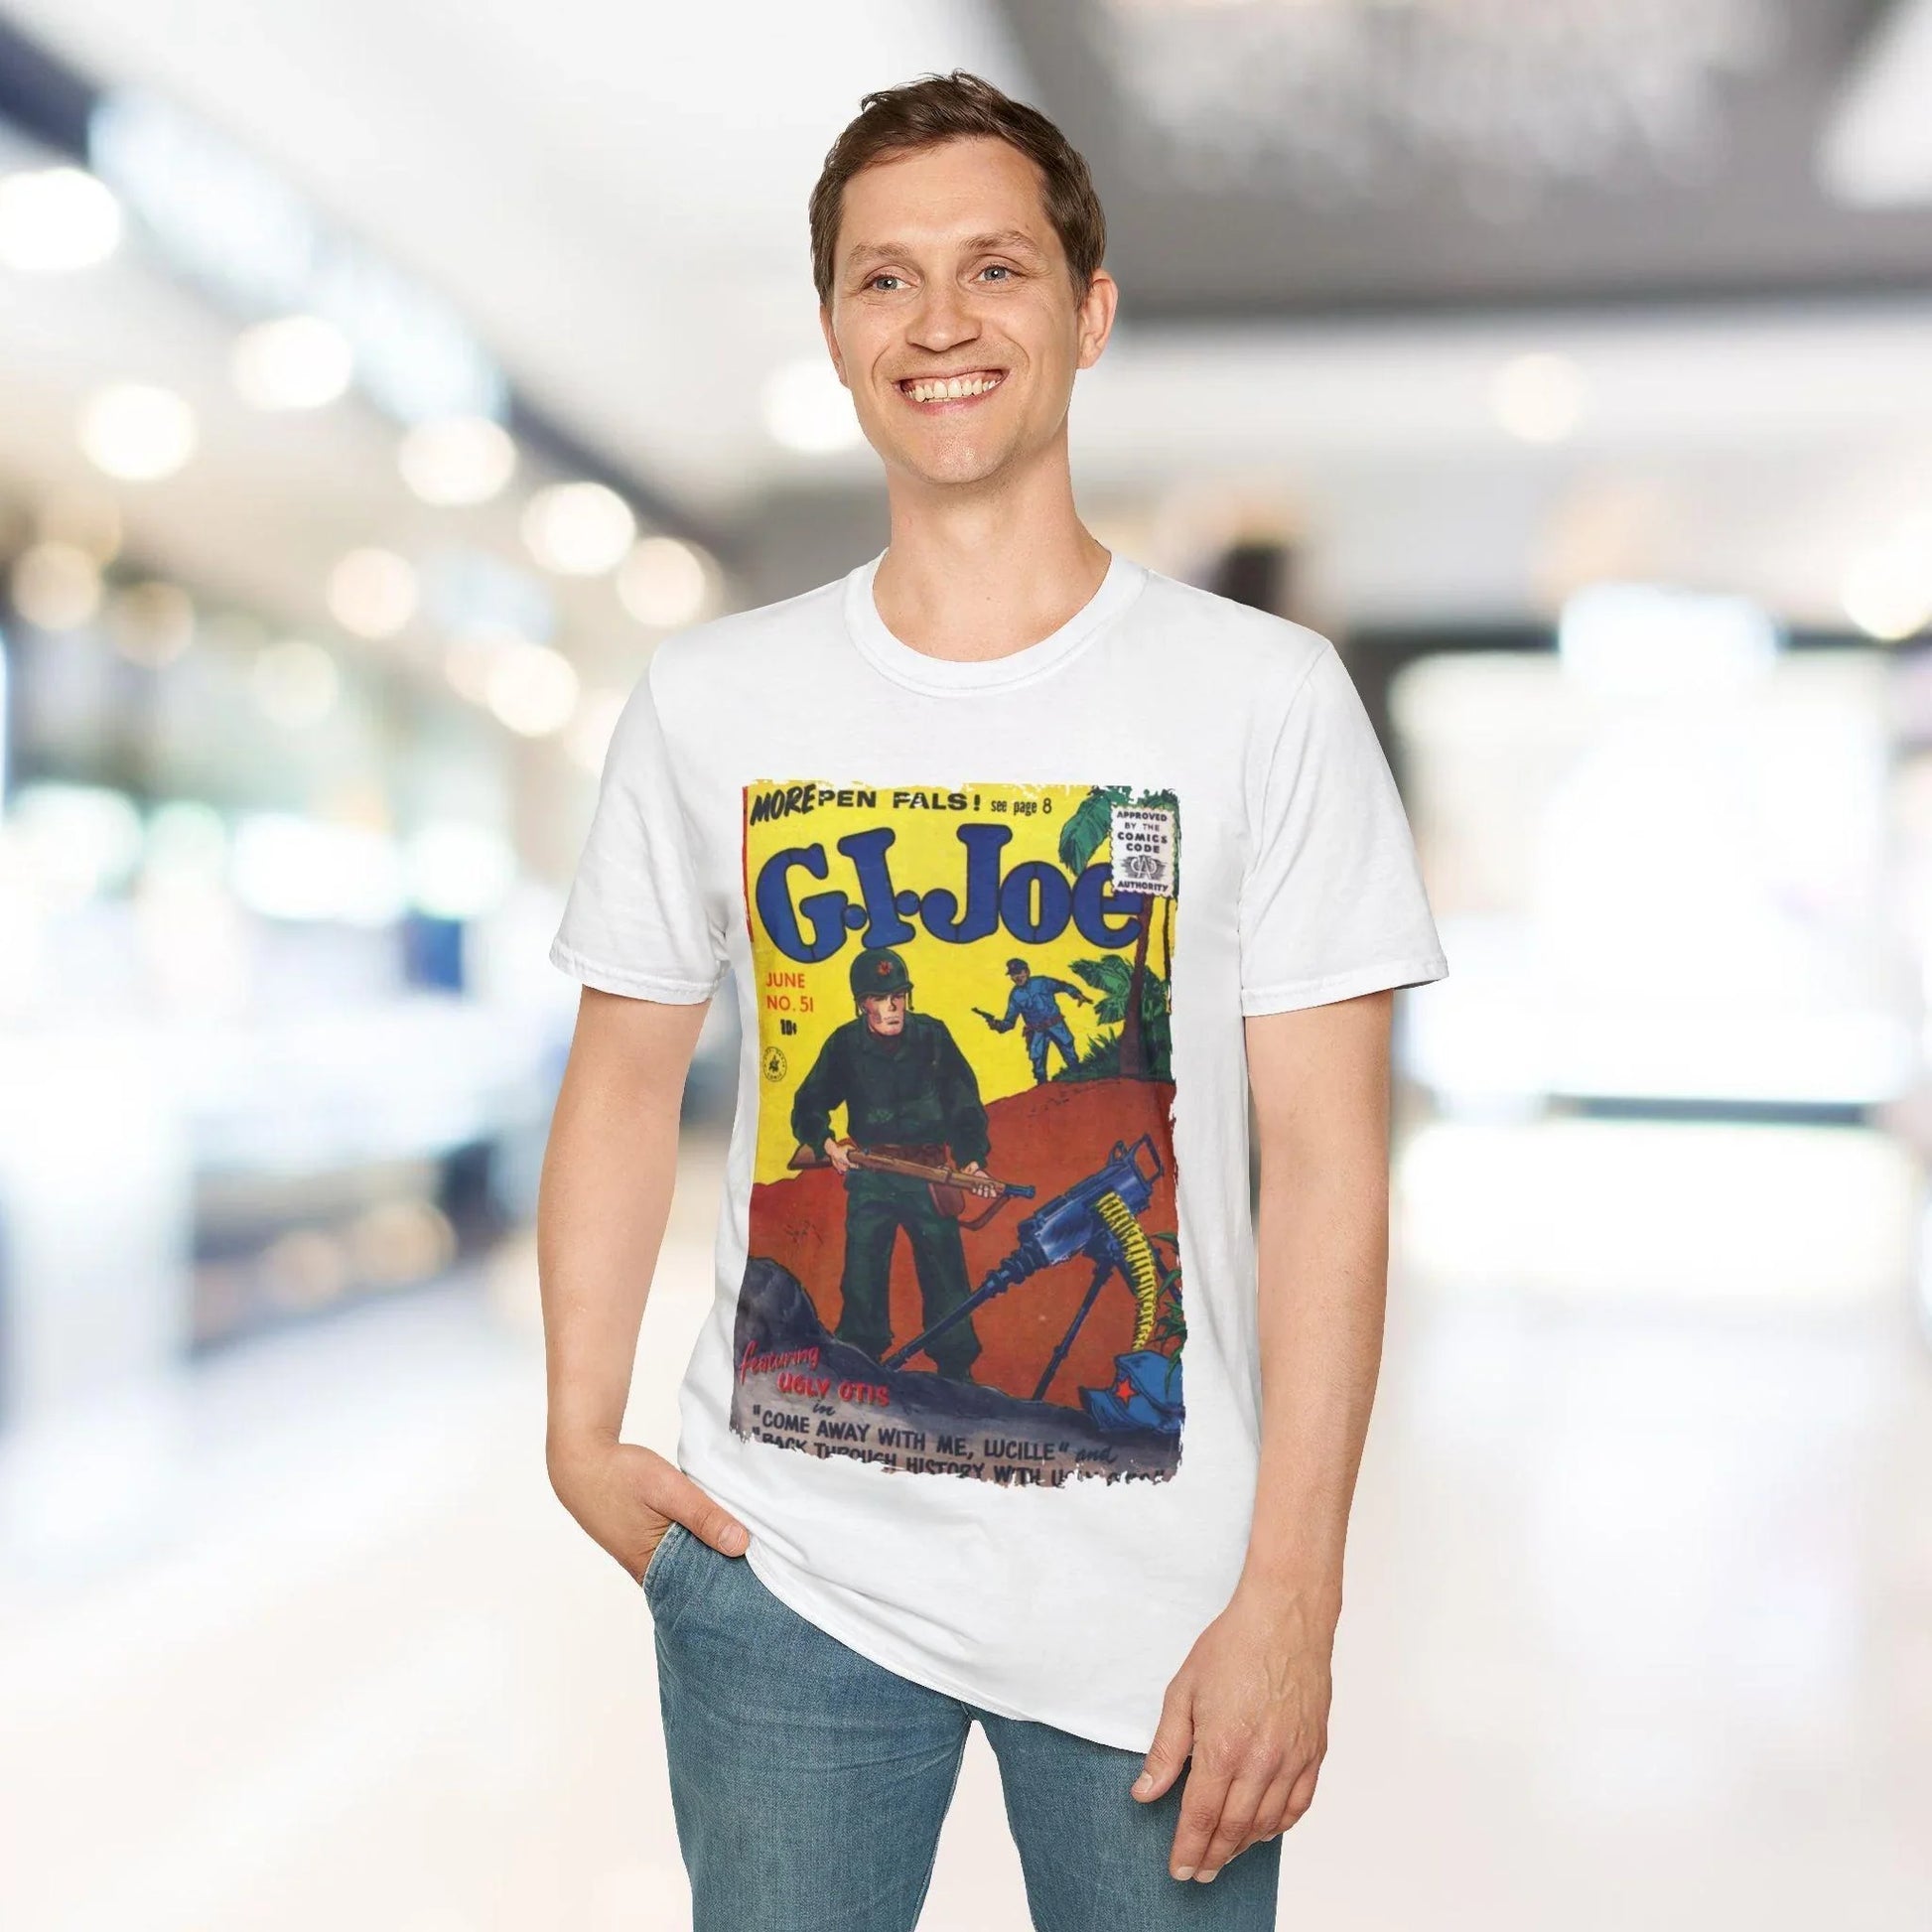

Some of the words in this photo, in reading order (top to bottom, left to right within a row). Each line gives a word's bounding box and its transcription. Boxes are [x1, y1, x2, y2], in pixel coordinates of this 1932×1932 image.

[750, 783, 816, 826] MORE
[818, 789, 877, 808] PEN
[991, 799, 1008, 812] see
[1013, 799, 1037, 817] page
[1042, 797, 1052, 814] 8
[1117, 811, 1168, 822] APPROVED
[1143, 823, 1161, 832] THE
[1117, 832, 1169, 844] COMICS
[1126, 843, 1161, 854] CODE
[1117, 880, 1169, 892] AUTHORITY
[766, 972, 805, 989] JUNE
[766, 995, 796, 1011] NO.
[799, 996, 814, 1013] 51
[740, 1339, 820, 1386] featuring
[777, 1371, 832, 1400] UGLY
[838, 1380, 891, 1408] OTIS
[812, 1400, 836, 1417] in
[753, 1405, 810, 1434] "COME
[816, 1420, 871, 1443] AWAY
[878, 1427, 925, 1451] WITH
[936, 1435, 974, 1460] ME,
[984, 1439, 1070, 1460] LUCILLE"
[1074, 1446, 1120, 1464] and
